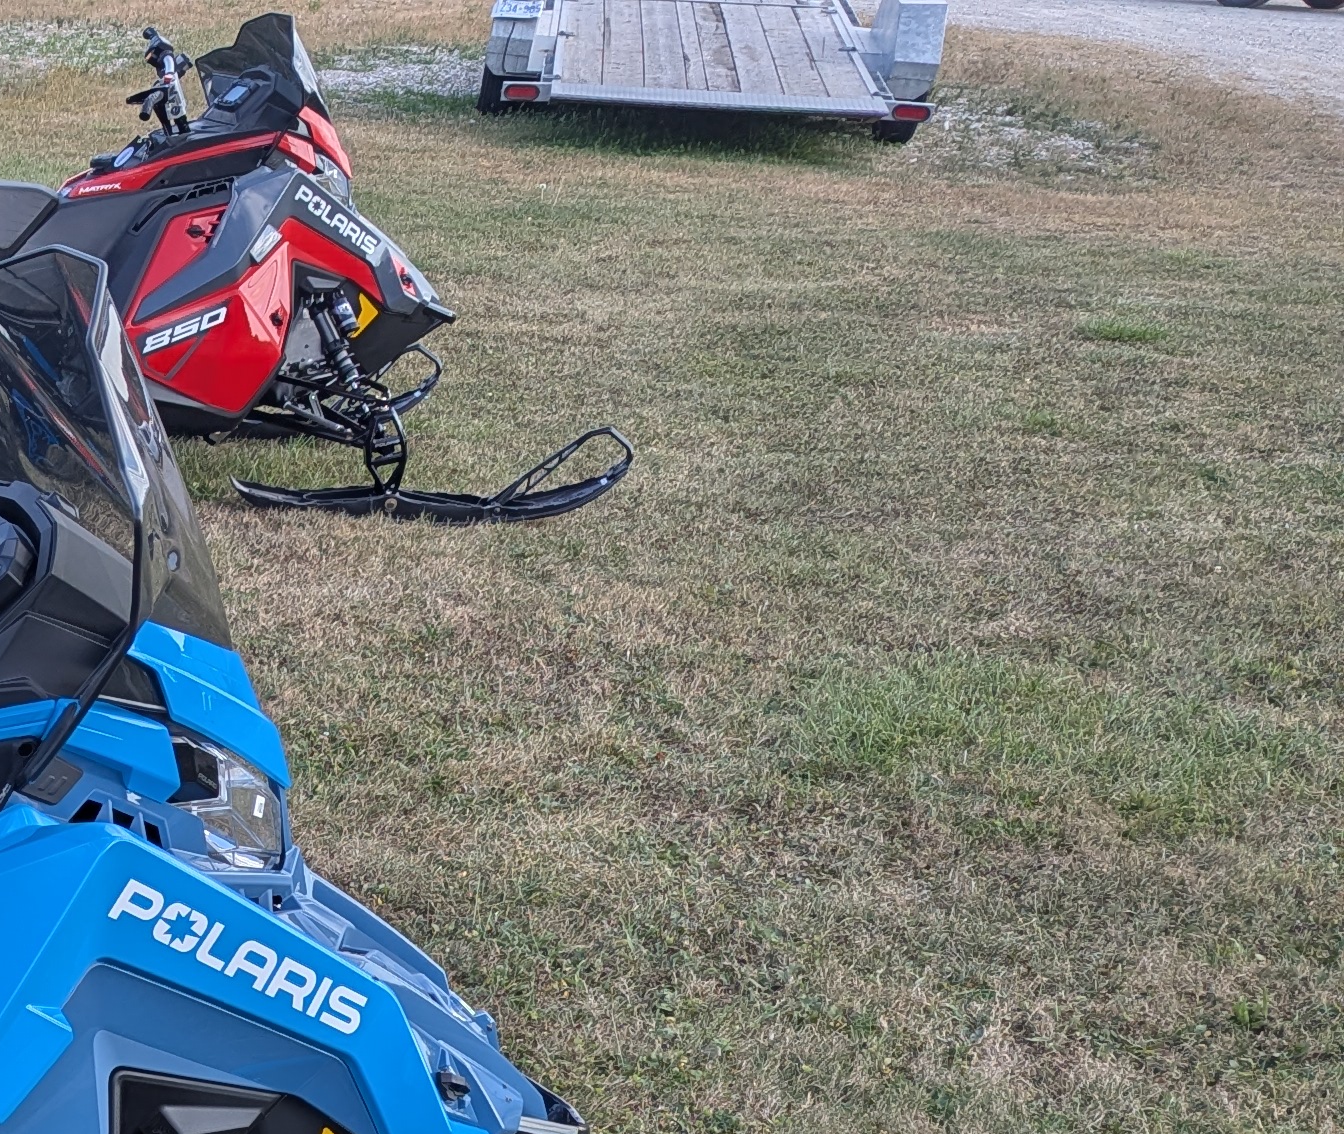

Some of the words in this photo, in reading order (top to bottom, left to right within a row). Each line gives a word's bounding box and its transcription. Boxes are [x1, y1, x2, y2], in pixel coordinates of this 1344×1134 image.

[78, 182, 121, 195] MATRYX
[294, 184, 377, 255] POLARIS
[142, 306, 227, 354] 850
[107, 878, 369, 1035] POLARIS
